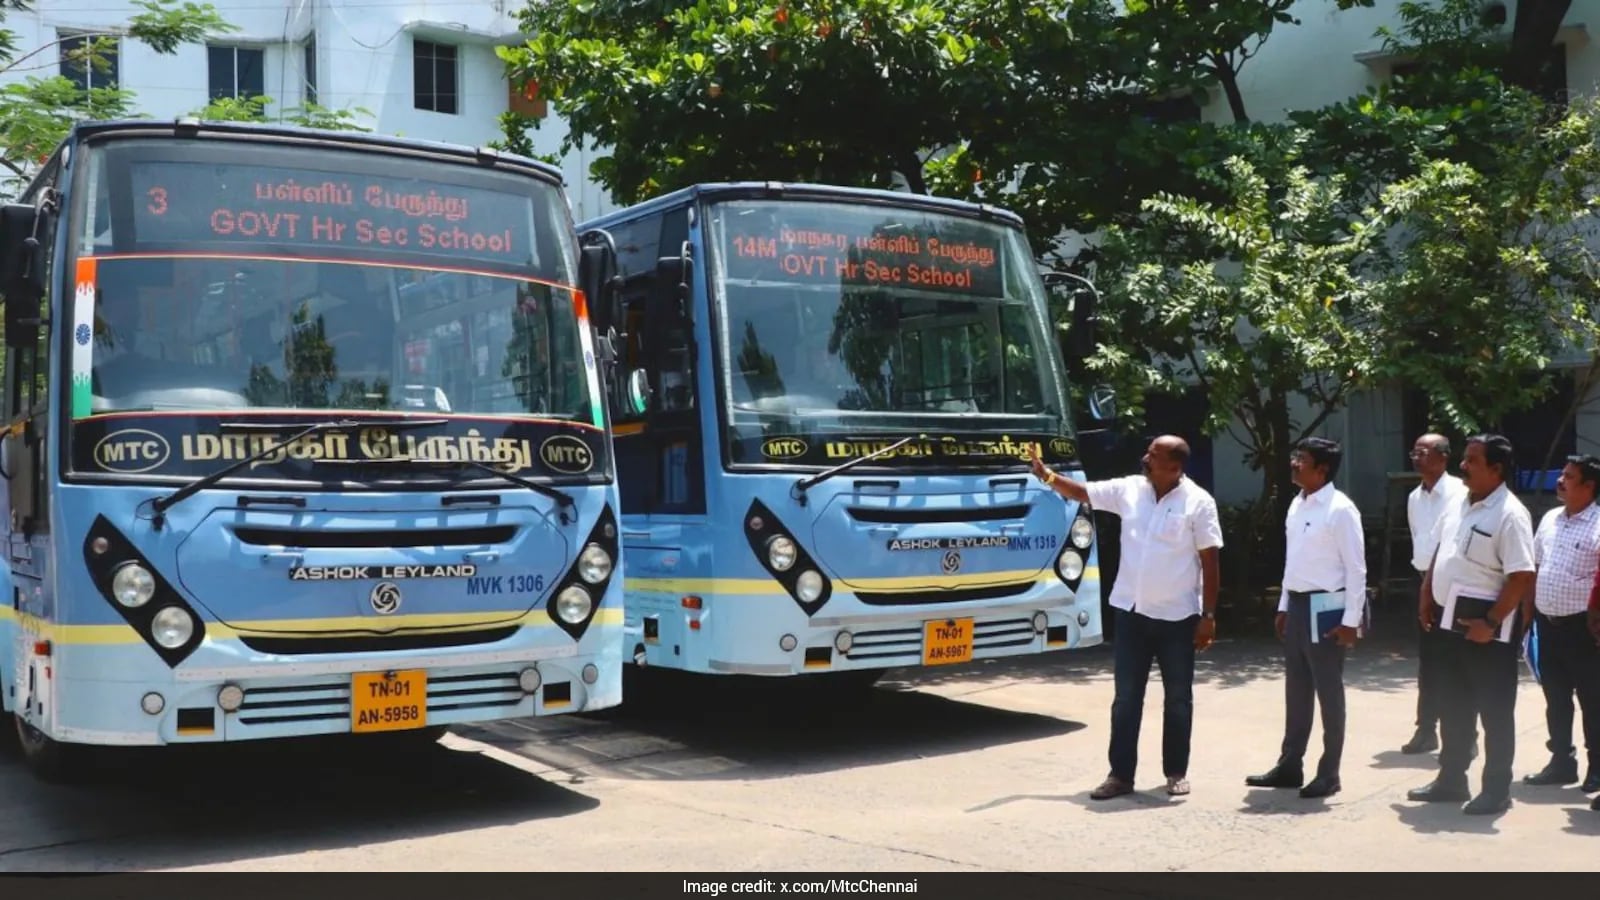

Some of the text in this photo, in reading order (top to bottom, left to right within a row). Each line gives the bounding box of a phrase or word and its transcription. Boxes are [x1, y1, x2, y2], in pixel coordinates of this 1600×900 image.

[147, 186, 169, 215] 3
[255, 178, 468, 221] பள்ளிப் பேருந்து
[210, 208, 513, 253] GOVT Hr Sec School
[732, 235, 778, 259] 14M
[855, 233, 919, 255] பள்ளிப்
[926, 237, 994, 268] பேருந்து
[780, 254, 971, 288] OVT Hr Sec School
[103, 440, 158, 462] MTC
[359, 427, 533, 475] பேருந்து
[547, 445, 588, 465] MTC
[768, 442, 801, 456] MTC
[889, 537, 1009, 551] ASHOK LEYLAND
[293, 565, 476, 580] ASHOK LEYLAND
[466, 575, 544, 596] MVK 1306
[935, 626, 963, 640] TN-01
[368, 680, 411, 698] TN-01
[358, 705, 419, 725] AN-5958
